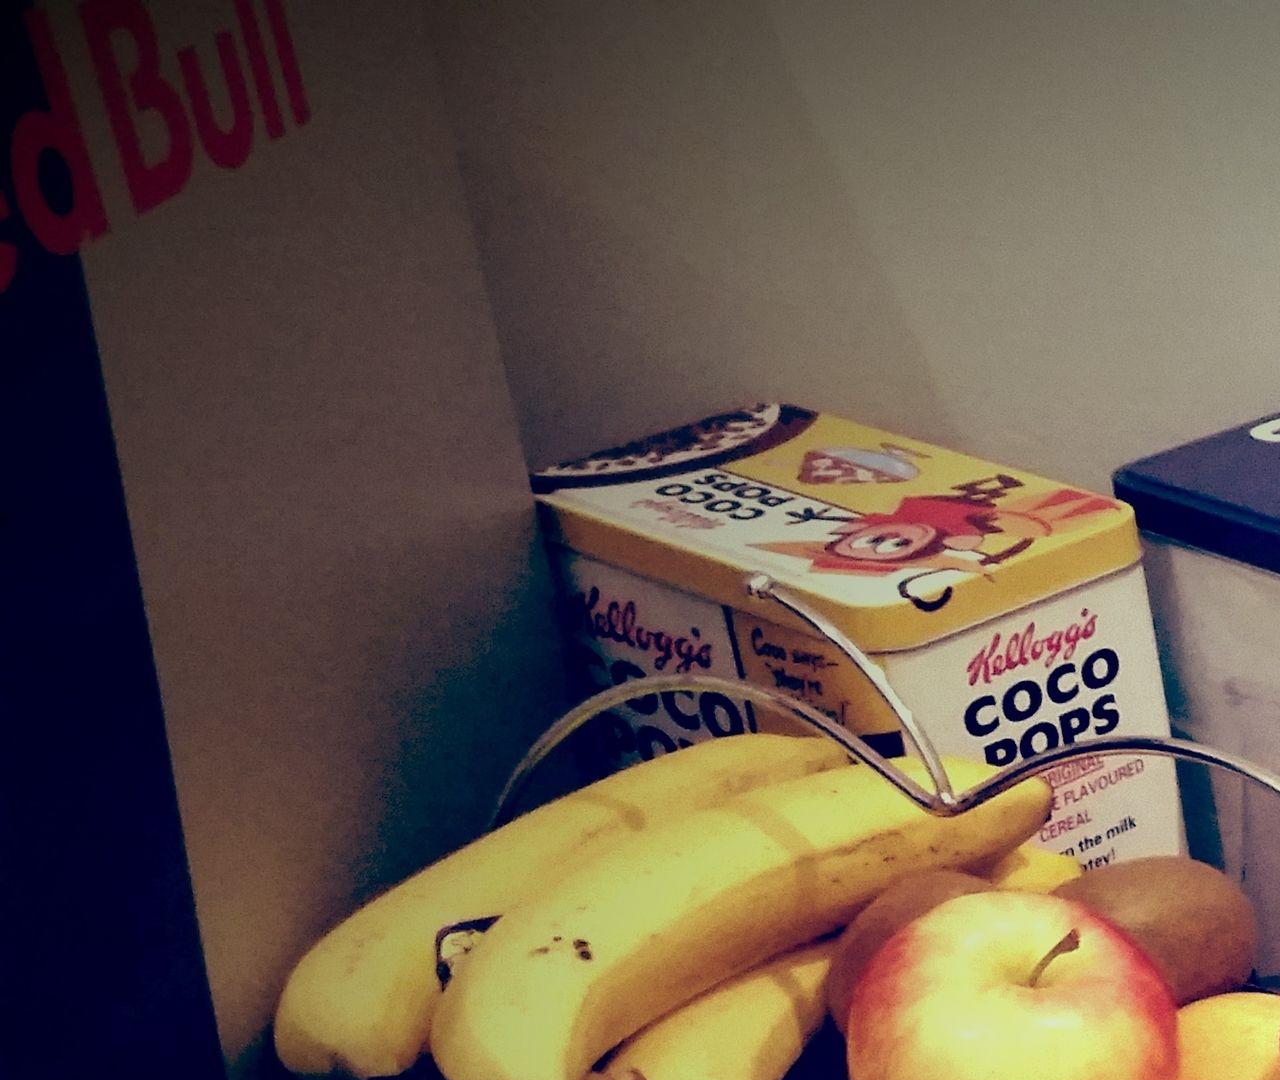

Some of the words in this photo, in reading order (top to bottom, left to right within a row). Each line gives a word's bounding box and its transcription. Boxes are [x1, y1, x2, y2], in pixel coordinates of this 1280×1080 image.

[78, 0, 311, 216] Bull
[656, 483, 764, 521] COCO
[693, 473, 795, 508] POPS
[966, 608, 1099, 686] Kellogg's
[964, 648, 1120, 737] COCO
[984, 694, 1120, 767] POPS
[1064, 758, 1145, 805] FLAVOURED
[1040, 810, 1093, 843] CEREAL
[1078, 834, 1102, 853] the
[1106, 814, 1138, 839] milk
